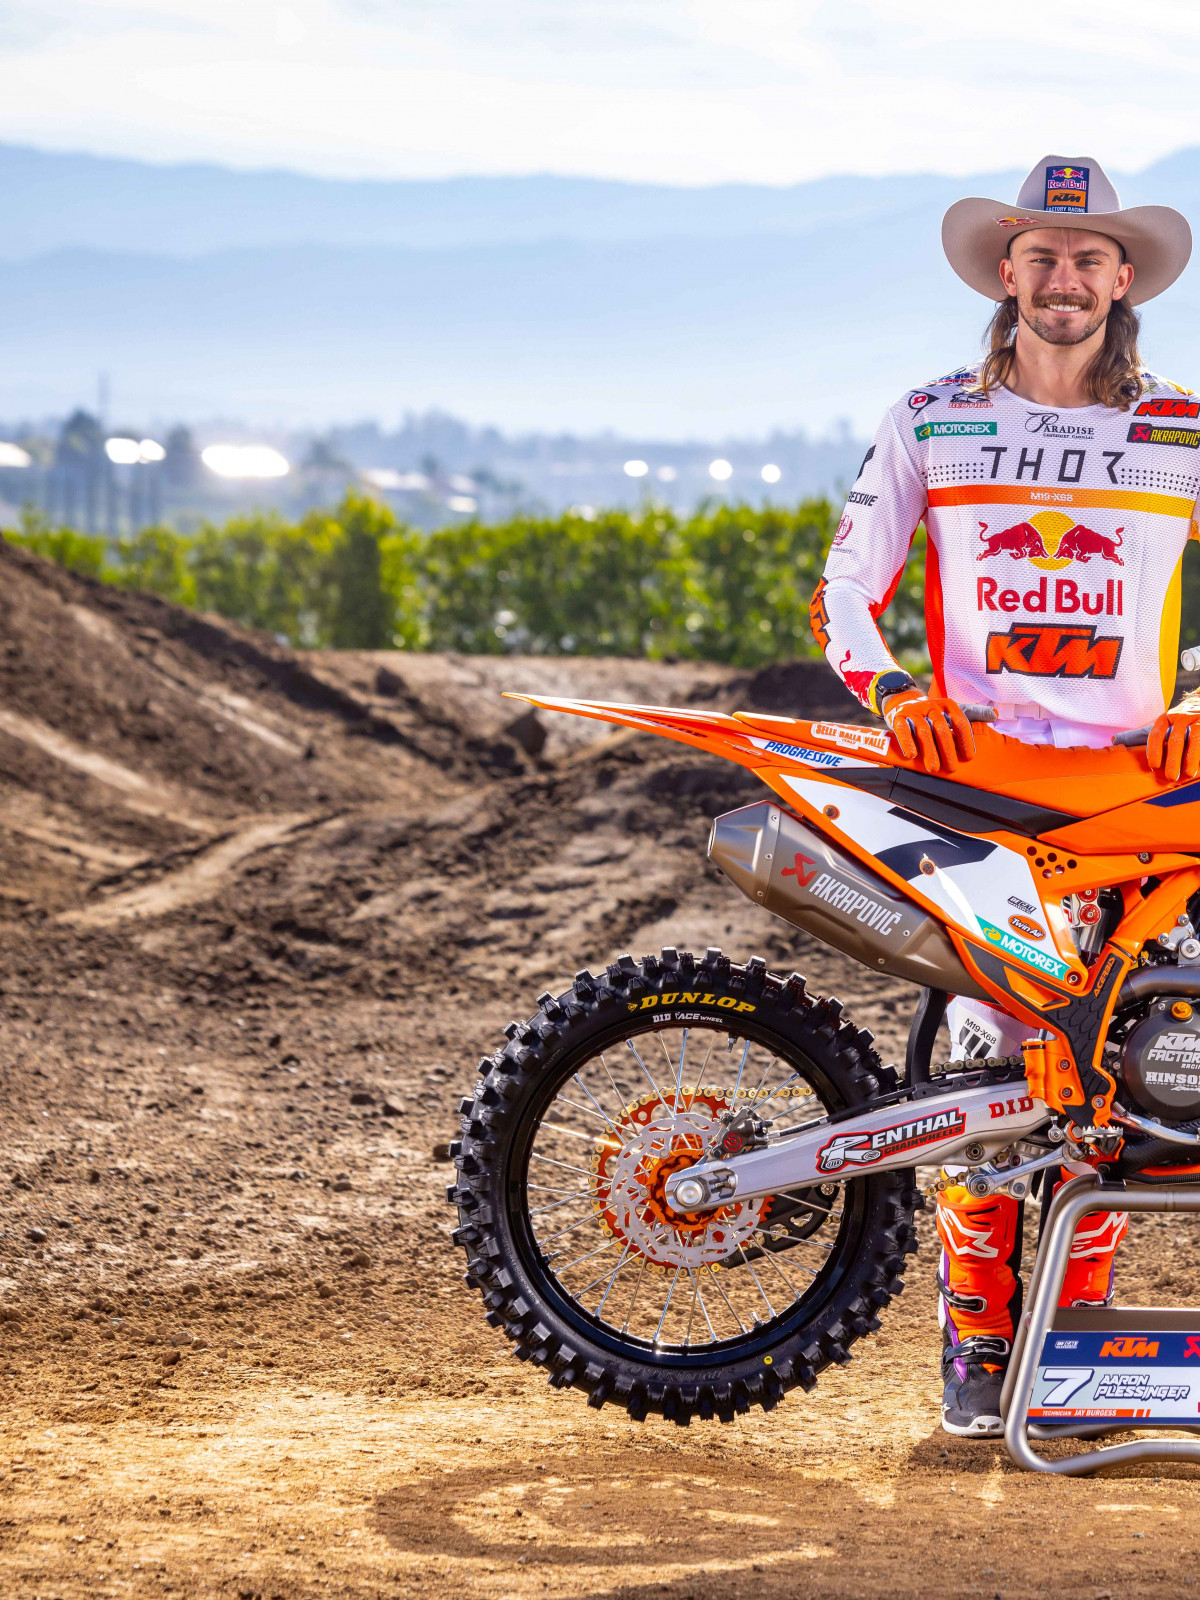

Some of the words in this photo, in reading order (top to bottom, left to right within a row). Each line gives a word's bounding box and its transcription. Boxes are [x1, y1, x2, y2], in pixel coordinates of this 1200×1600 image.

[1048, 179, 1067, 188] Red
[1068, 179, 1086, 190] Bull
[1052, 193, 1081, 202] KTM
[1133, 399, 1200, 418] KTM
[933, 424, 991, 434] MOTOREX
[977, 577, 1047, 613] Red
[1055, 579, 1123, 616] Bull
[986, 623, 1124, 679] KTM
[815, 724, 837, 737] SELLE
[839, 730, 861, 743] DALLA
[864, 735, 887, 750] VALLE
[764, 741, 842, 767] PROGRESSIVE
[1011, 917, 1031, 933] Twin
[1030, 929, 1045, 938] Air
[1000, 934, 1064, 977] MOTOREX
[639, 992, 756, 1013] DUNLOP
[652, 1013, 671, 1023] DID
[965, 1018, 997, 1044] M19-X68
[884, 1126, 962, 1154] CHAINWHEELS
[1099, 1337, 1159, 1357] KTM
[1041, 1368, 1095, 1406] 7
[1100, 1374, 1150, 1386] AARON
[1093, 1385, 1190, 1401] PLESSINGER
